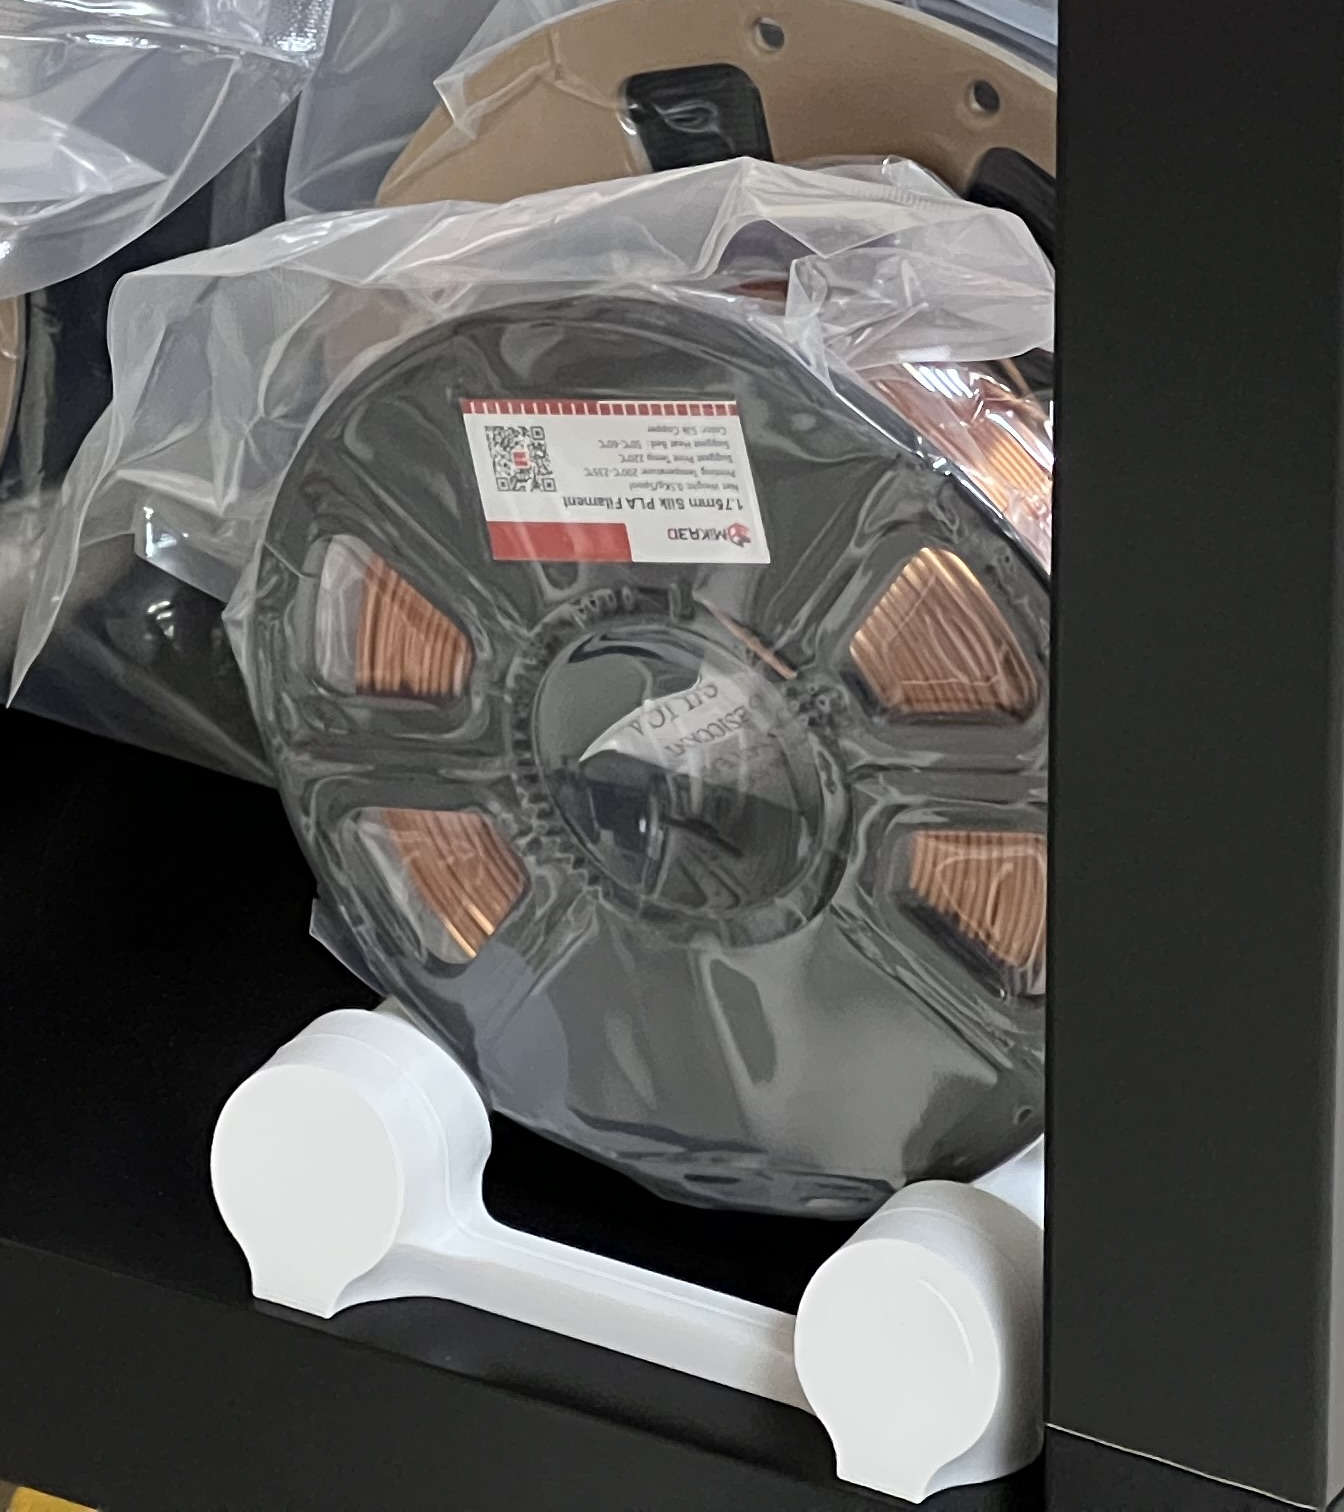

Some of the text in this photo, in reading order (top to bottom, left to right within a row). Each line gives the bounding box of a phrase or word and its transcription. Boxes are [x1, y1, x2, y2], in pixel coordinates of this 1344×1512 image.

[563, 495, 624, 510] Filament
[625, 497, 656, 510] PLA
[658, 497, 686, 510] Silk
